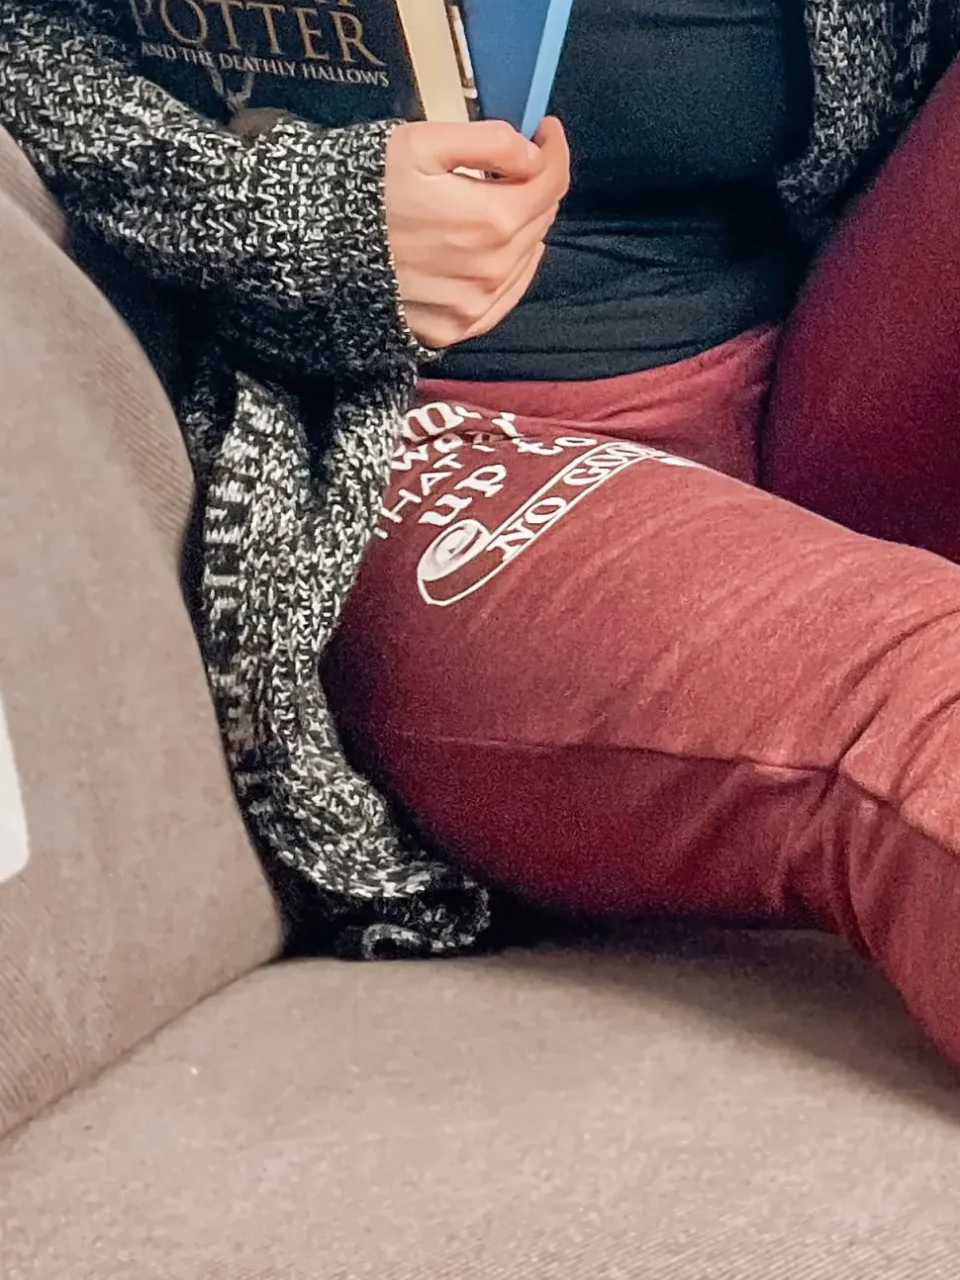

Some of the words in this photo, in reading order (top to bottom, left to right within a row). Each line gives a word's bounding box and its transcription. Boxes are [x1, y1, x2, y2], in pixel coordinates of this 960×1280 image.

[141, 41, 177, 62] AND
[183, 47, 214, 69] THE
[219, 52, 297, 78] DEATHLY
[301, 63, 391, 89] HALLOWS
[486, 496, 567, 562] NO
